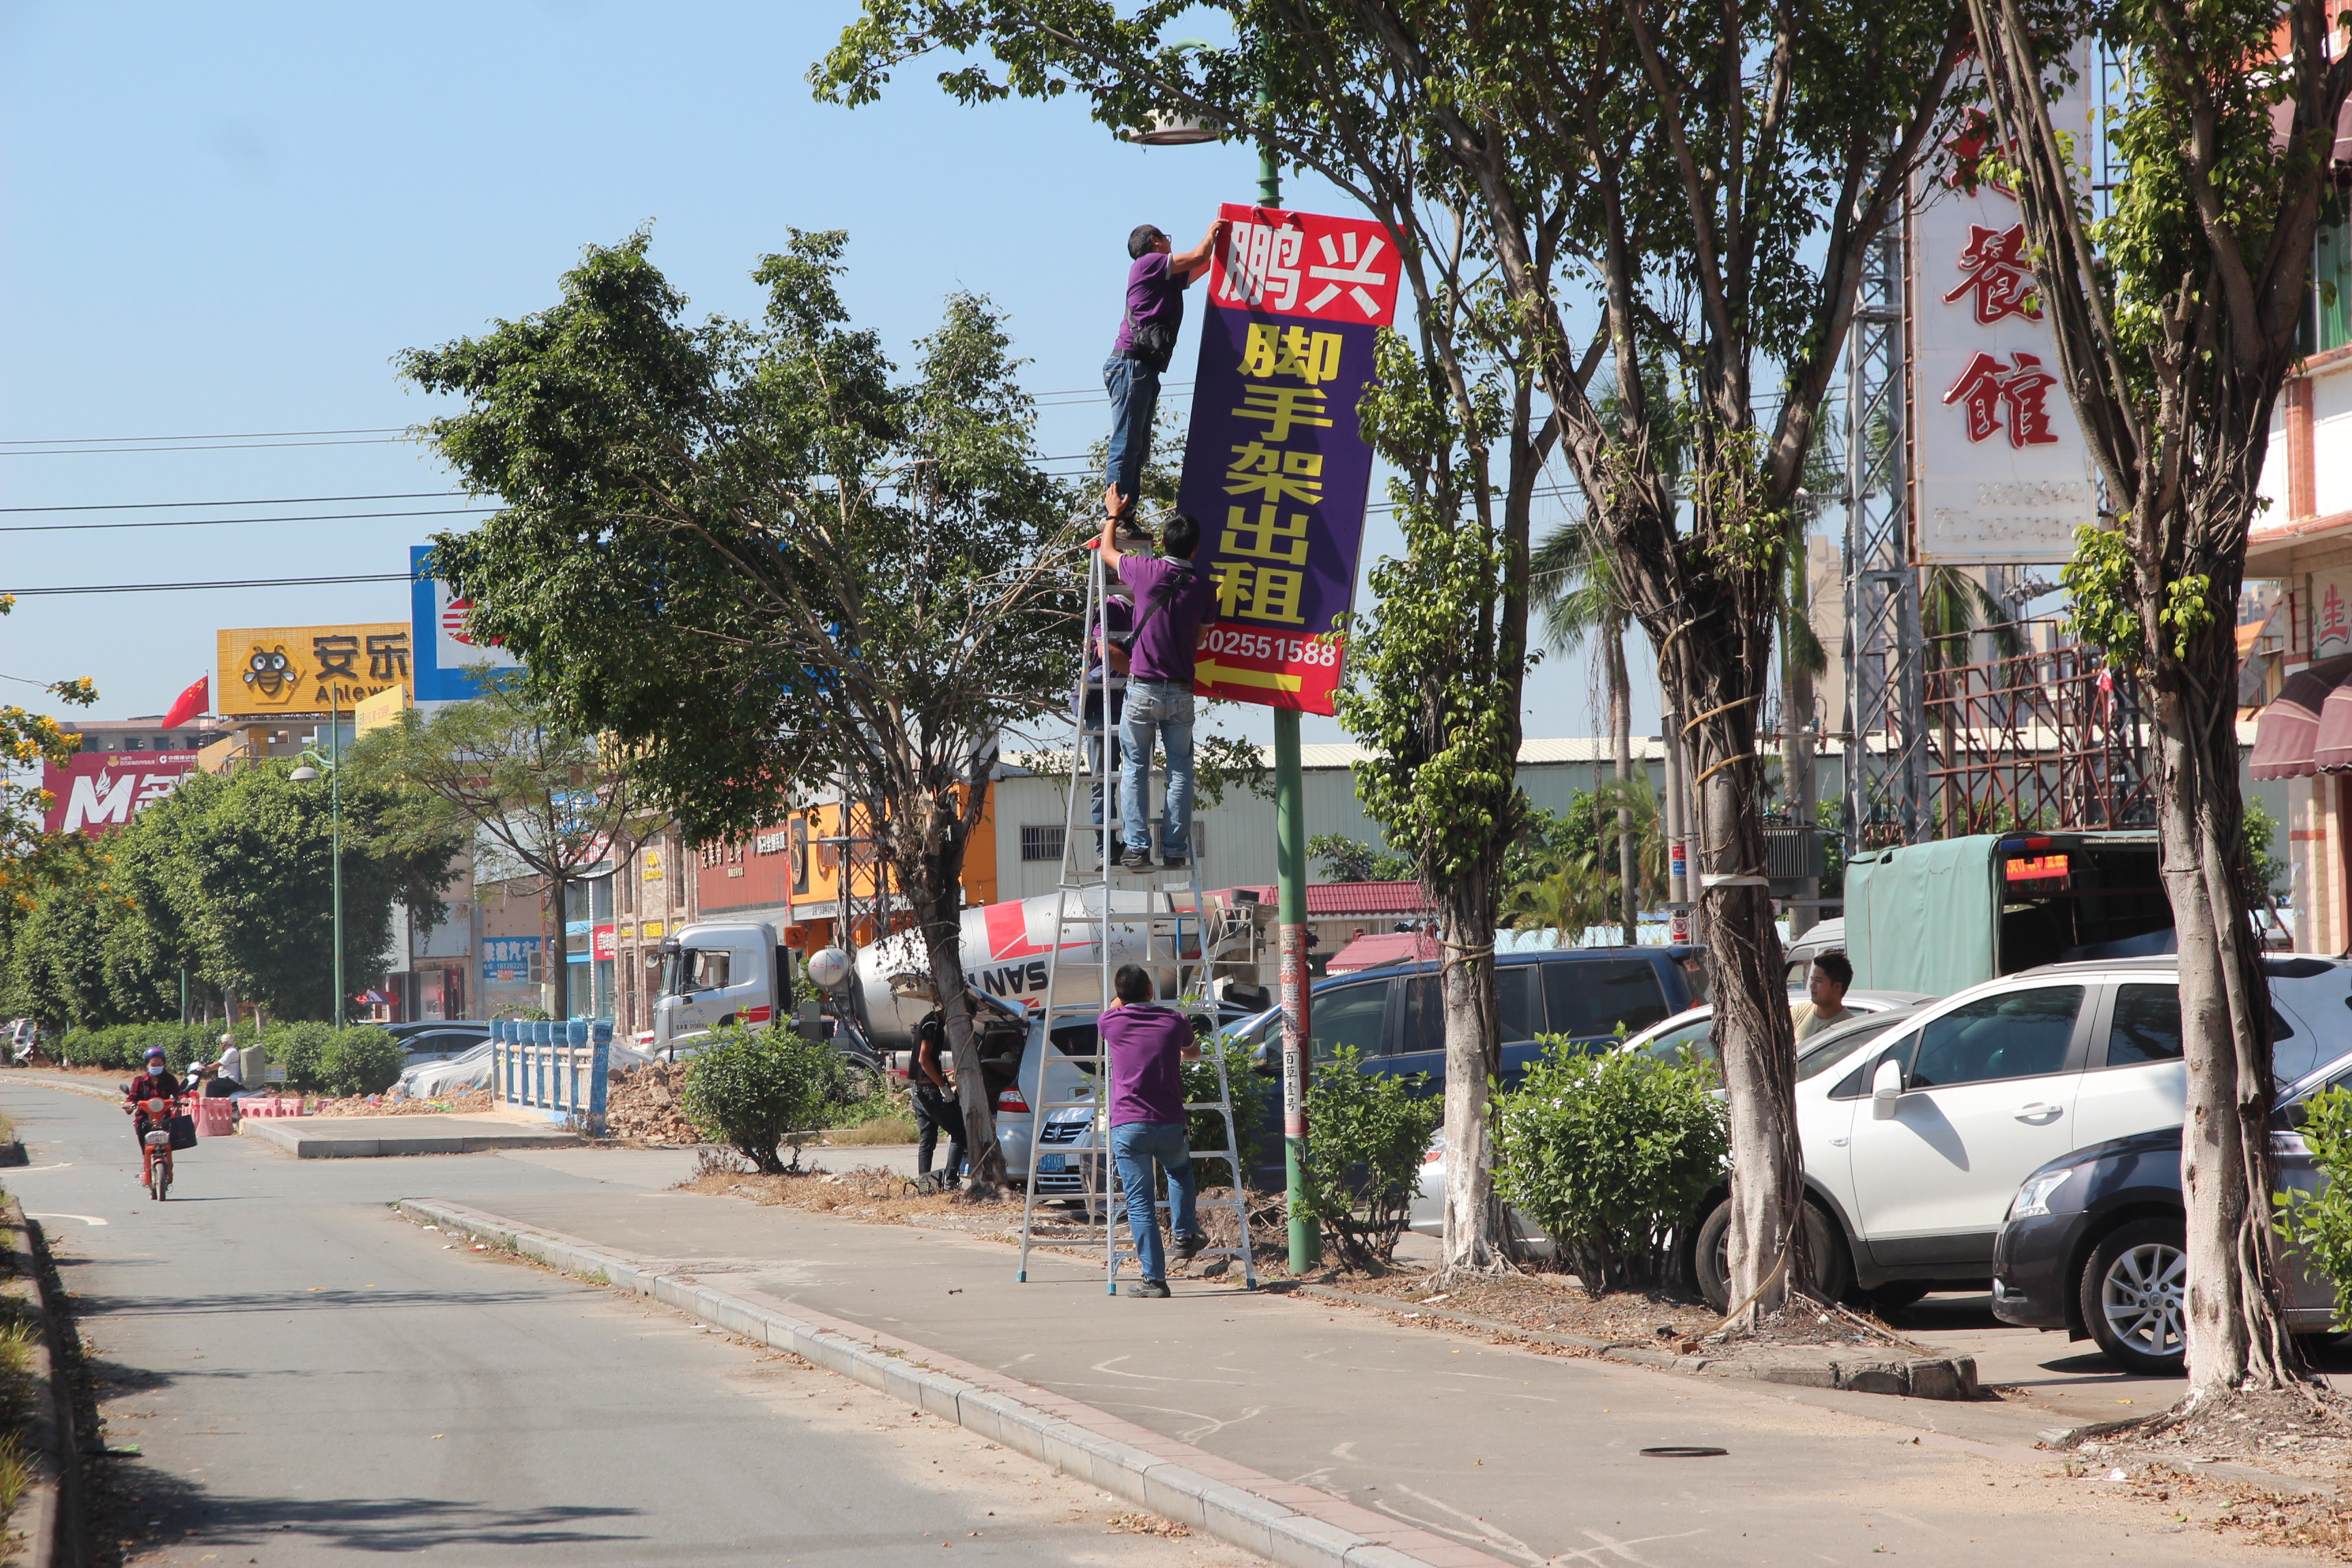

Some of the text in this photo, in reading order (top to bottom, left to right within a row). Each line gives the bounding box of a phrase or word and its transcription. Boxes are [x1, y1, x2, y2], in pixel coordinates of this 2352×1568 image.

[1218, 221, 1386, 318] 鹏兴
[1210, 322, 1343, 624] 脚手架出租
[313, 632, 408, 681] 安乐
[1285, 1051, 1298, 1111] 百草壹号
